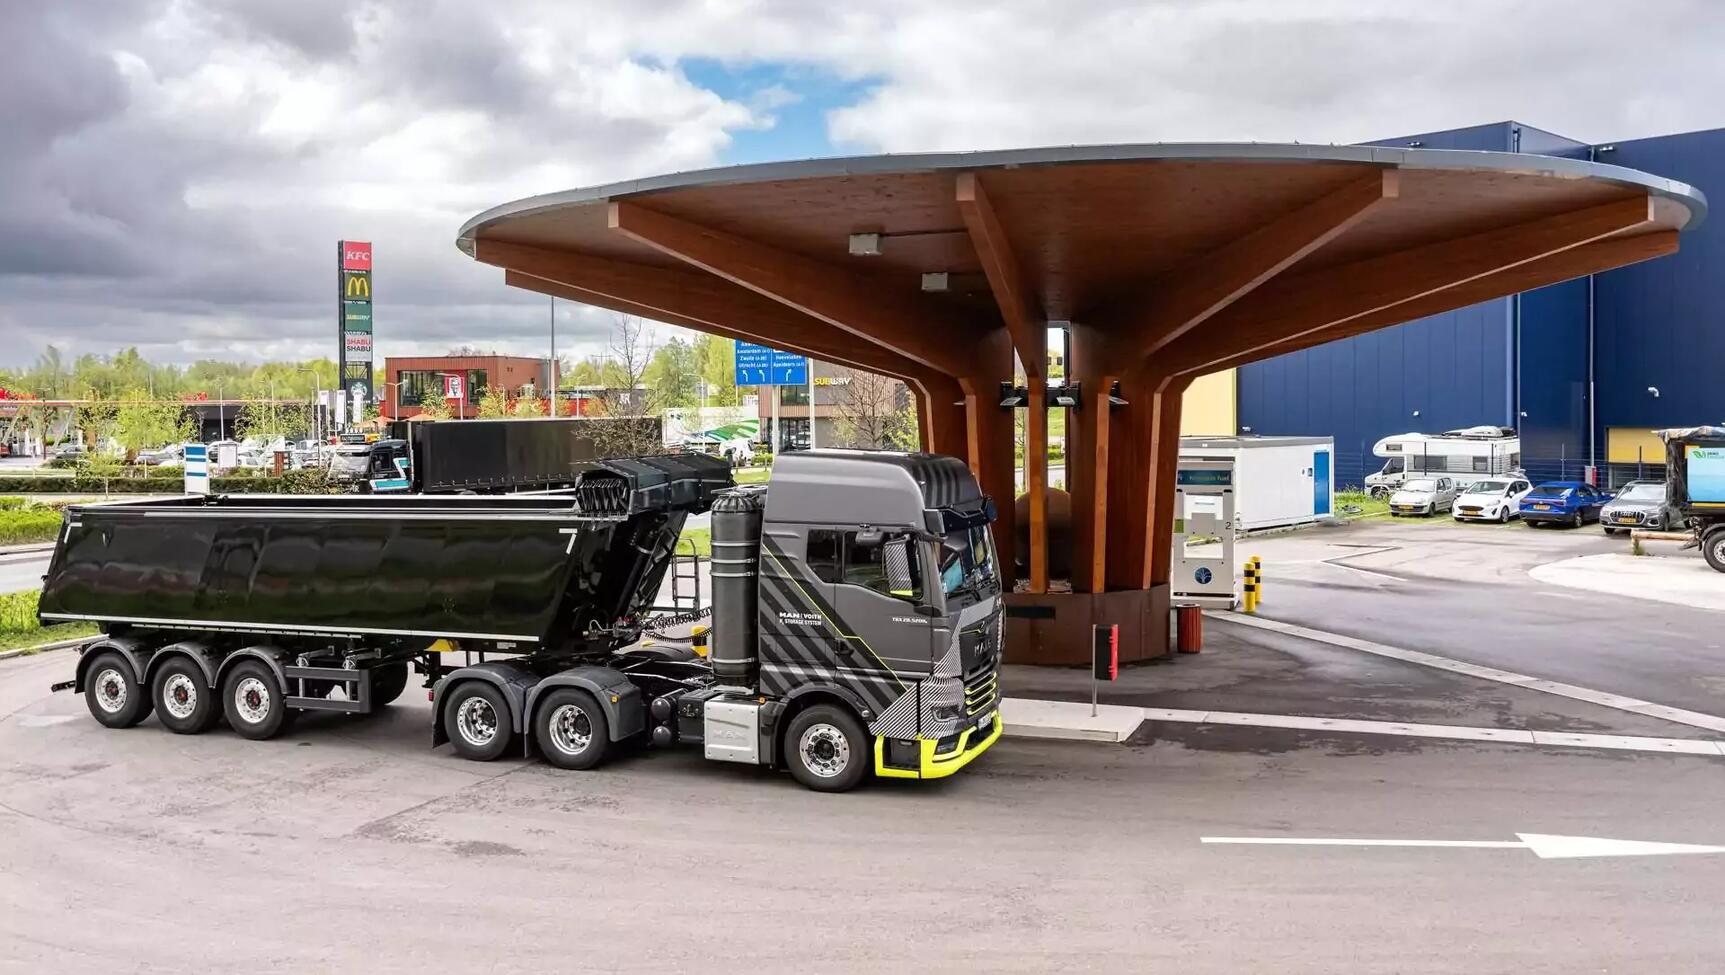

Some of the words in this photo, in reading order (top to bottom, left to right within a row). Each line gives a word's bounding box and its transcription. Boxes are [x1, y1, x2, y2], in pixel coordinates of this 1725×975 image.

[346, 251, 370, 260] KFC
[814, 377, 852, 386] SUBWAY
[1225, 521, 1232, 530] 2
